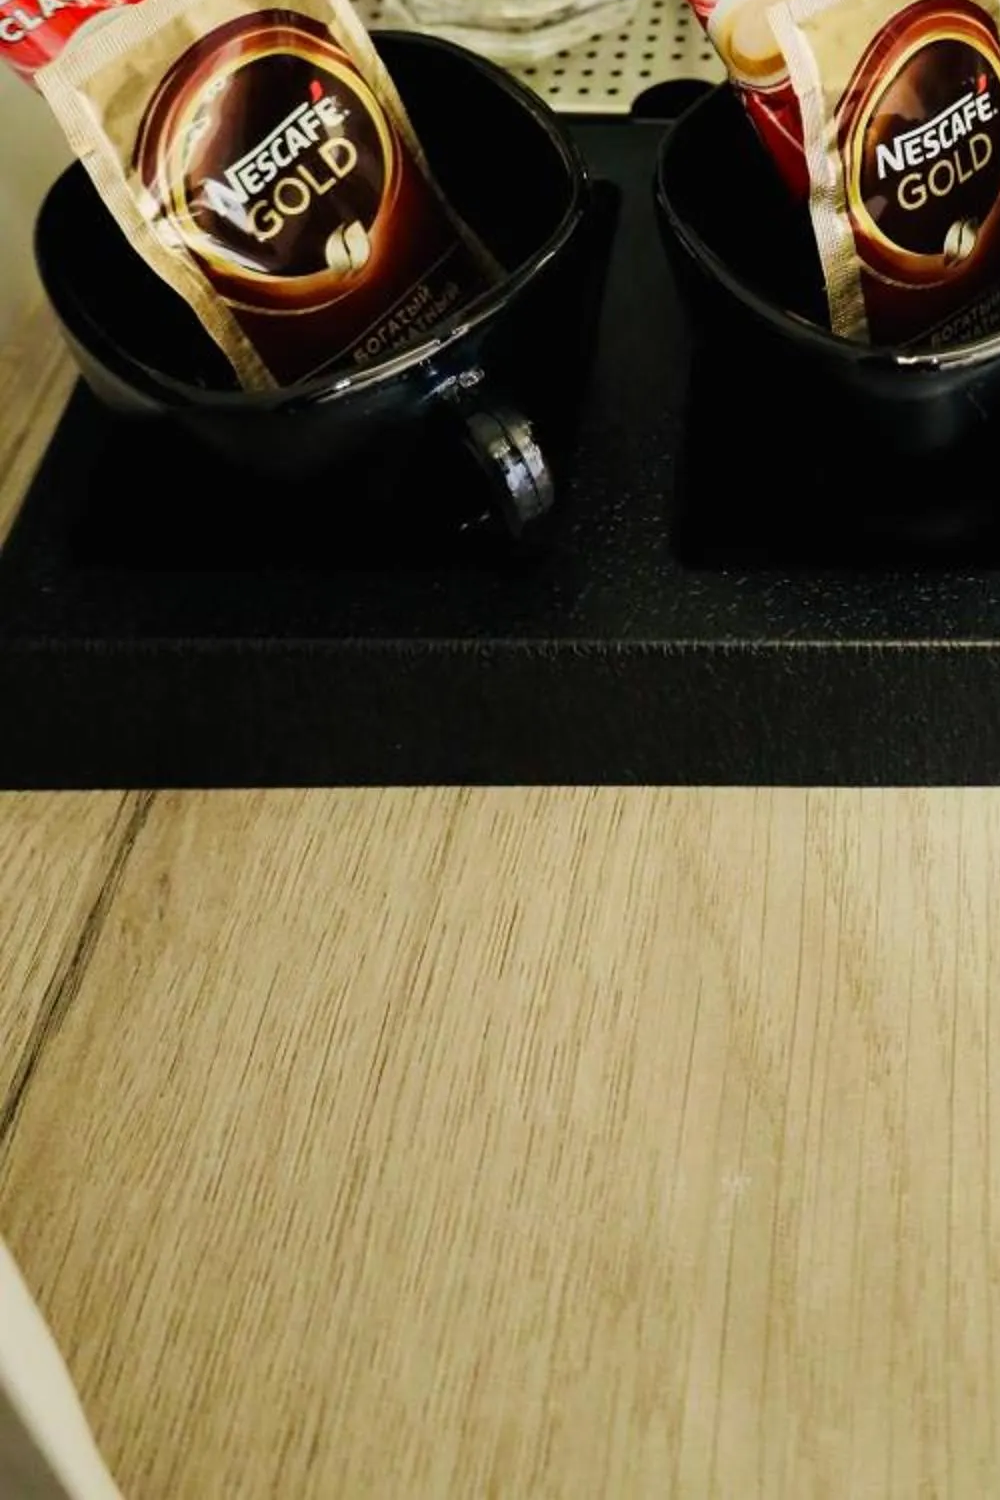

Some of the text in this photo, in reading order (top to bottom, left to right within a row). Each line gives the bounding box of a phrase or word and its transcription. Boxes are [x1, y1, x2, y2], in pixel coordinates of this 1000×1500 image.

[877, 73, 997, 180] NESCAFÉ
[897, 133, 993, 211] GOLD
[246, 136, 358, 242] GOLD
